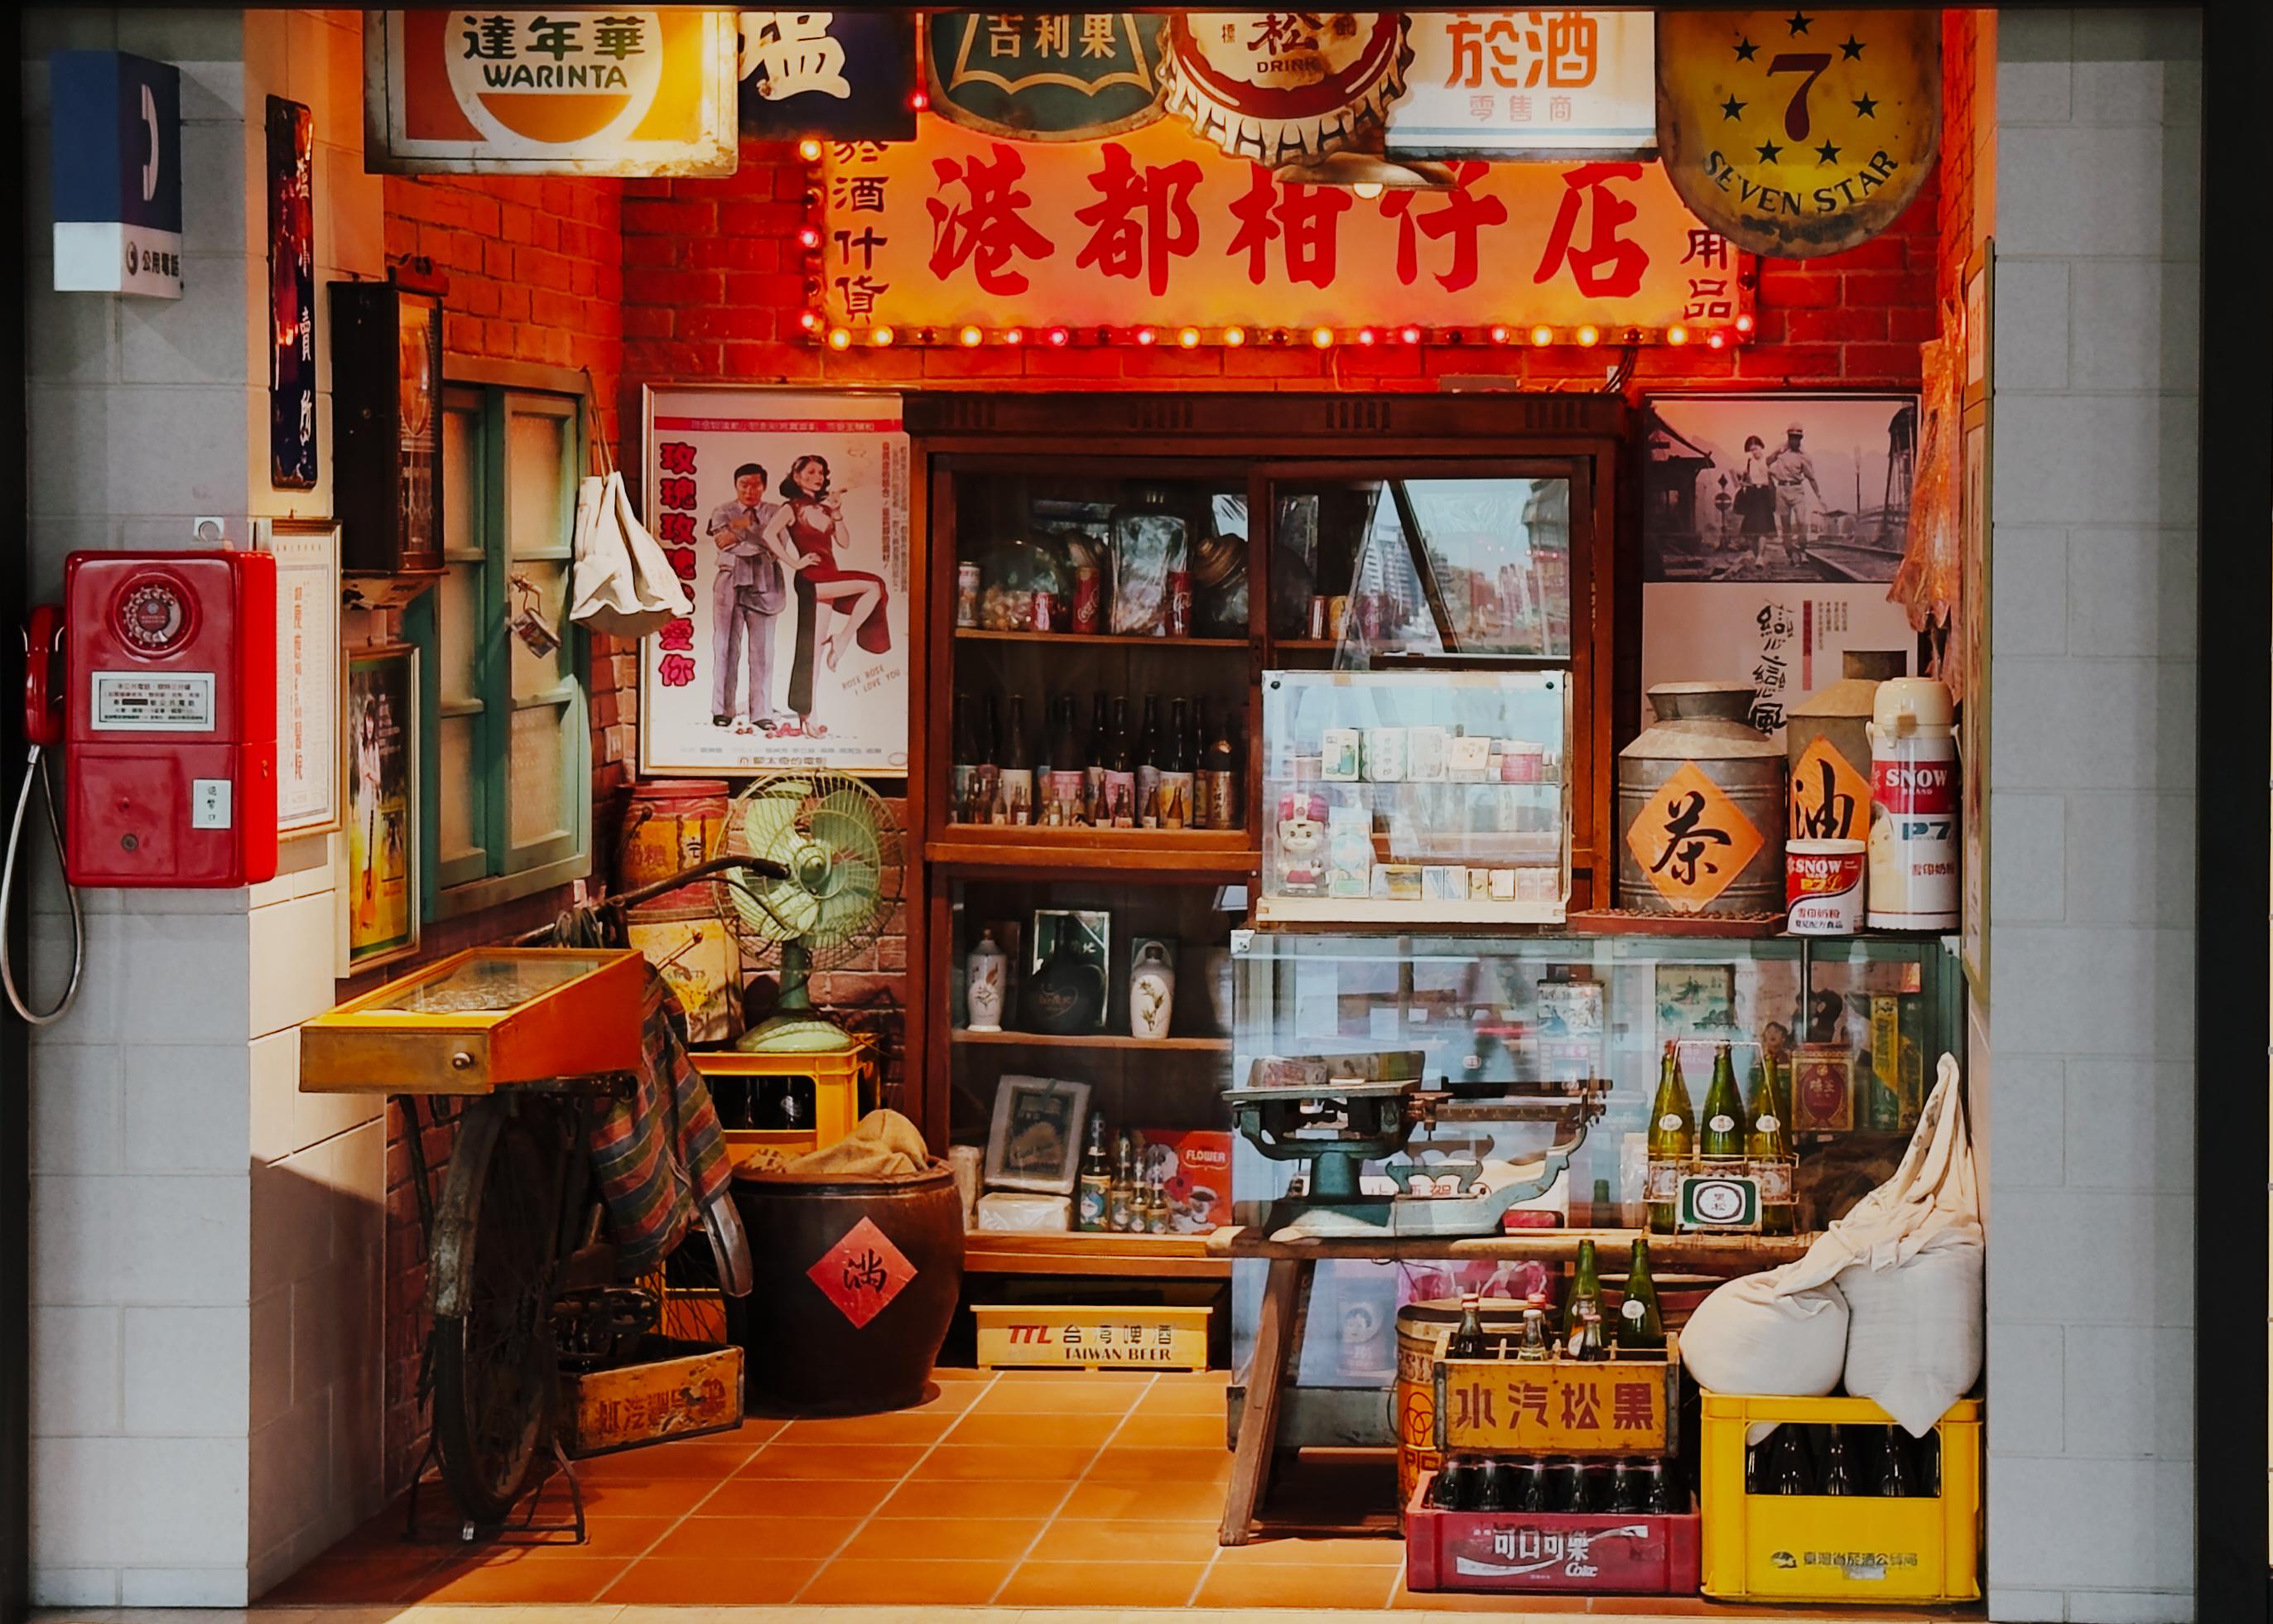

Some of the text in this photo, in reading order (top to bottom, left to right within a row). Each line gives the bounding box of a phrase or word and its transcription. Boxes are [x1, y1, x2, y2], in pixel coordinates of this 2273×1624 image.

[483, 63, 628, 89] WARINTA
[1469, 95, 1572, 123] 零售商
[1766, 53, 1832, 143] 7
[1702, 149, 1900, 216] SEVEN STAR
[924, 142, 1650, 299] 港都柑仔店
[659, 441, 697, 687] 玫瑰玫瑰愛你
[1885, 768, 1948, 788] SNOW
[1793, 758, 1855, 839] 油
[1650, 790, 1732, 886] 茶
[1902, 821, 1952, 841] P7
[1795, 858, 1842, 875] SNOW
[1007, 1324, 1052, 1344] TTL
[1065, 1347, 1172, 1361] TAIWAN BEER
[1494, 1528, 1591, 1562] 可口可樂
